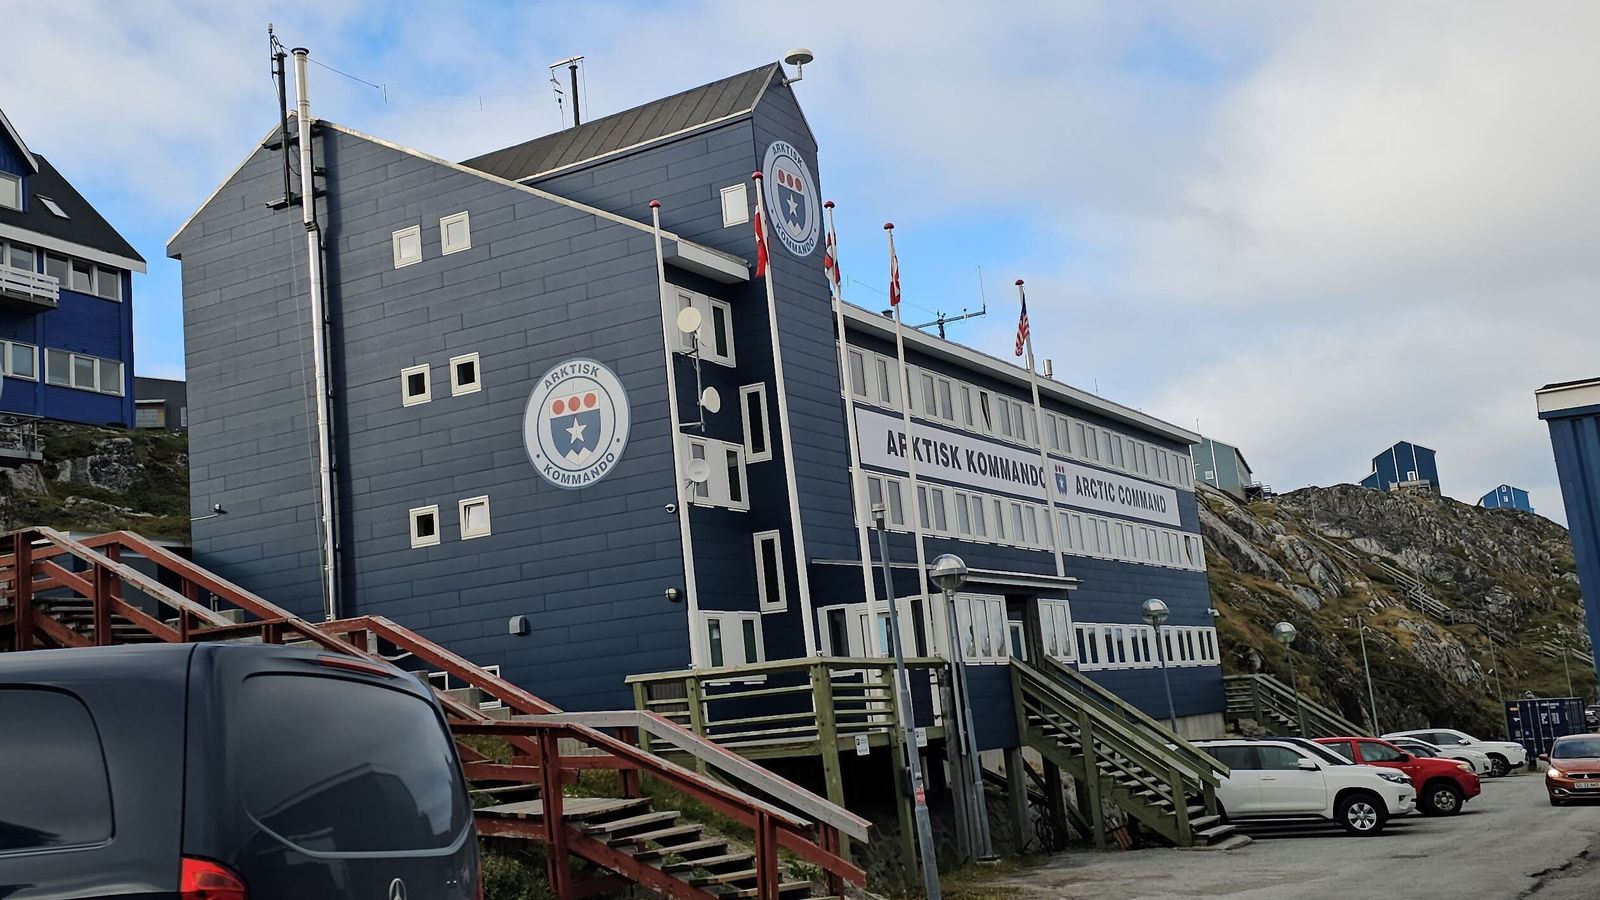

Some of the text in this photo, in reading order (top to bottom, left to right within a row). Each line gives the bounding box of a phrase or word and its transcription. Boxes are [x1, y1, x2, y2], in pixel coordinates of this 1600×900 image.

[772, 143, 803, 167] ARKTISK
[775, 222, 815, 255] KOMMANDO
[544, 363, 600, 390] ARKTISK
[887, 429, 962, 470] ARKTISK
[543, 452, 615, 485] KOMMANDO
[1076, 475, 1166, 513] ARCTIC COMMAND
